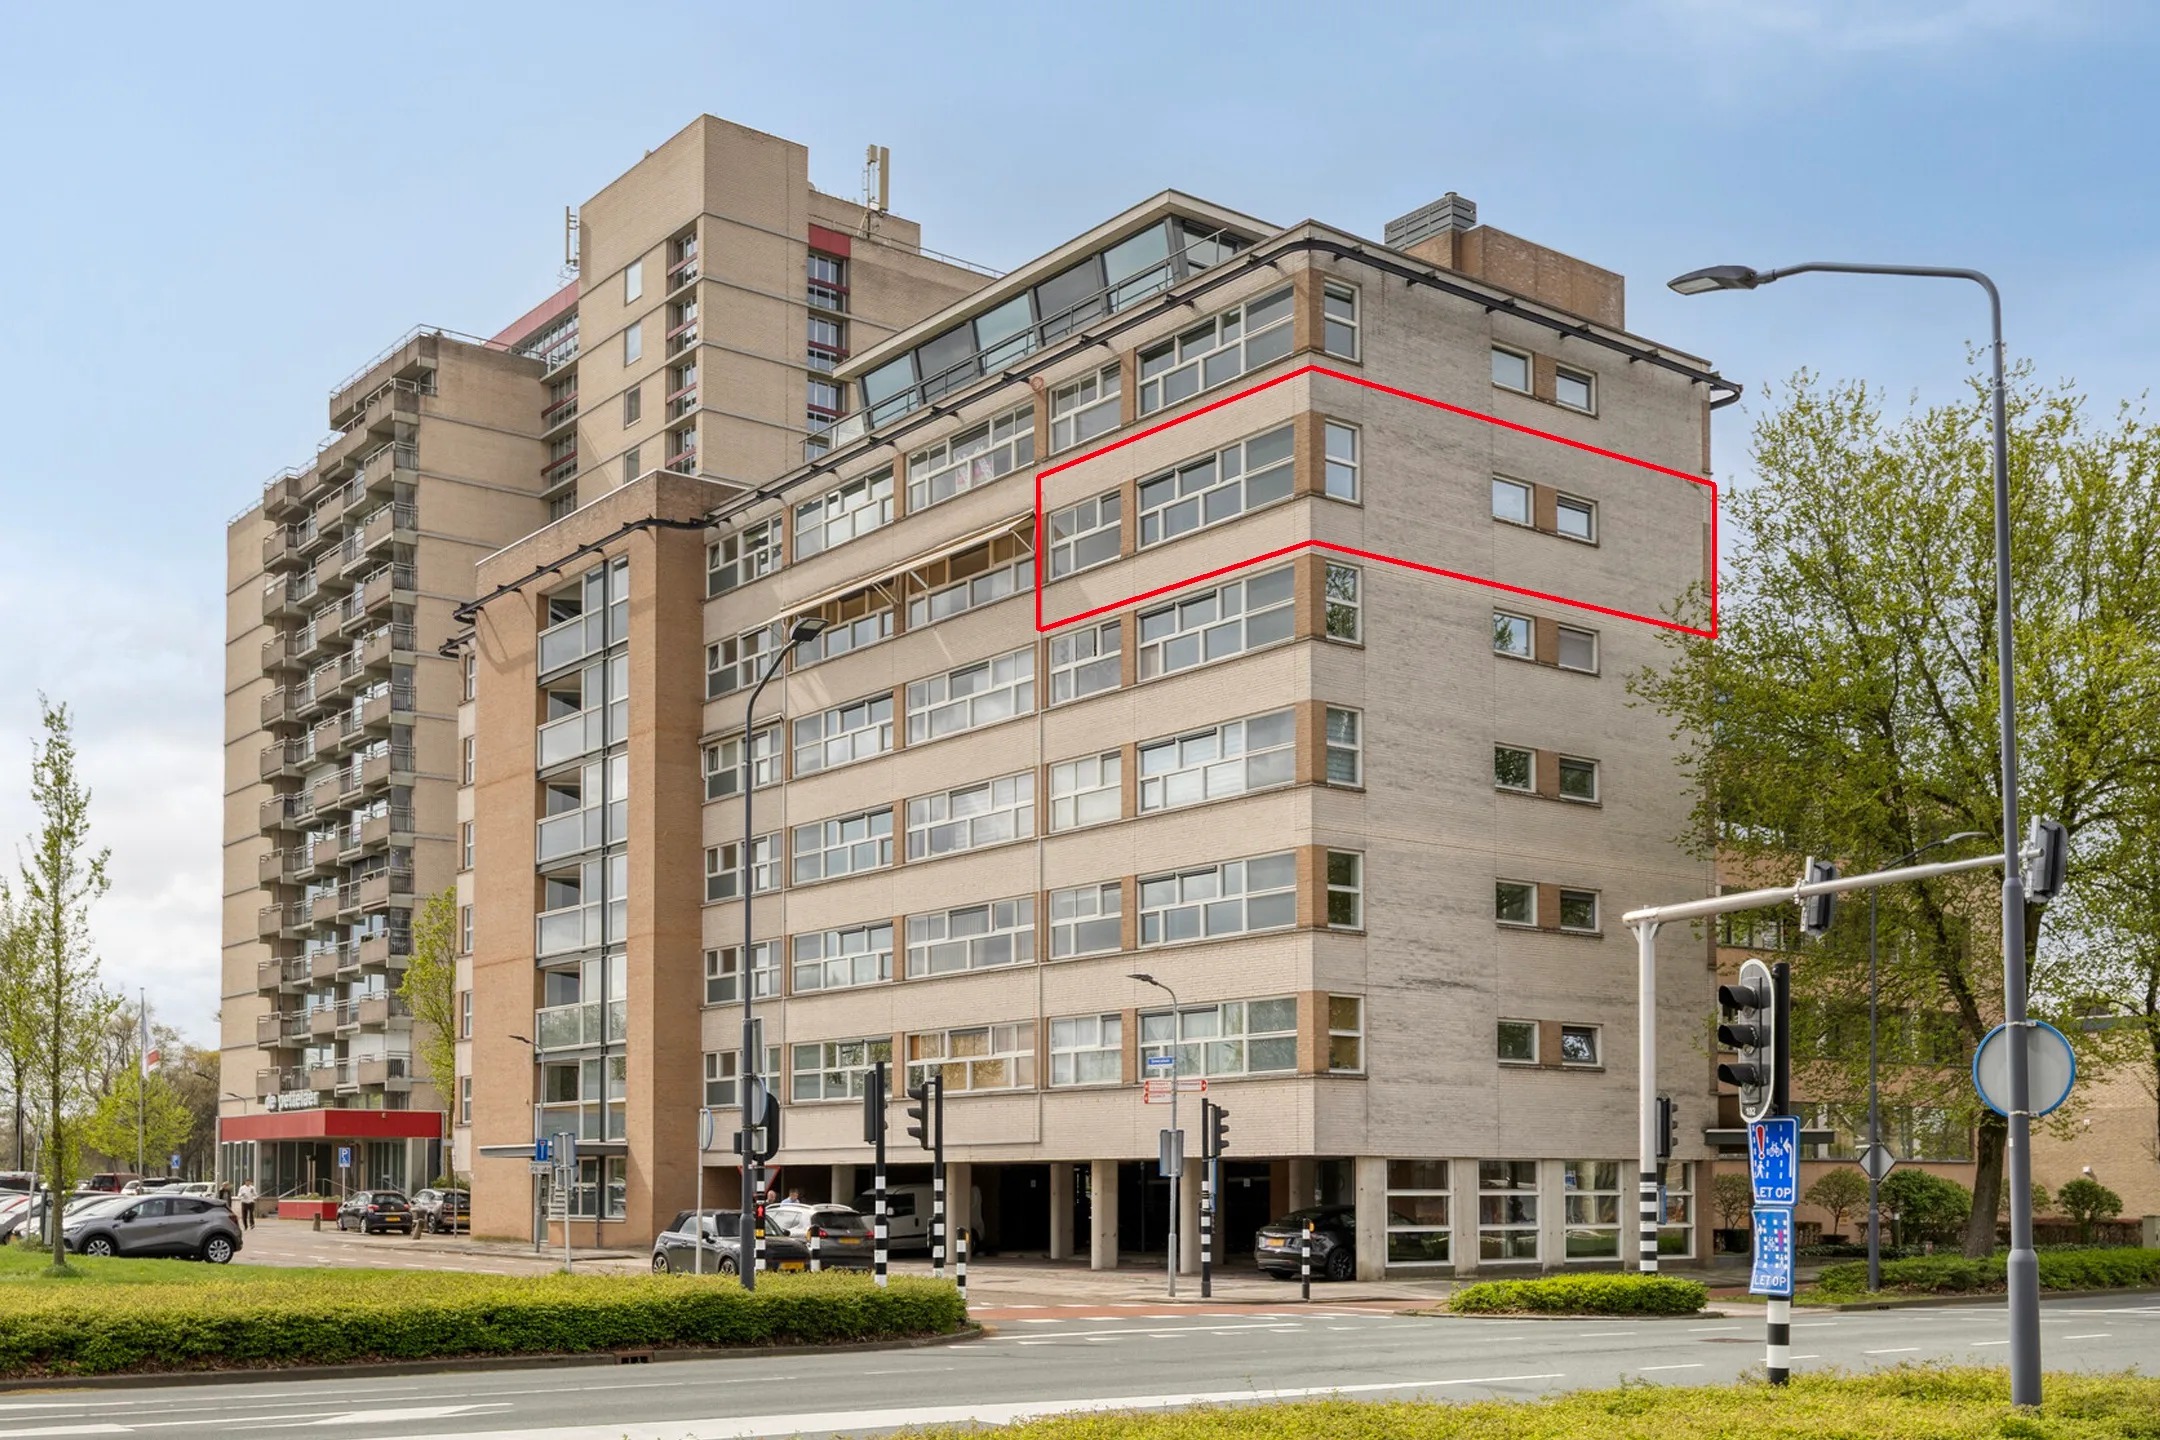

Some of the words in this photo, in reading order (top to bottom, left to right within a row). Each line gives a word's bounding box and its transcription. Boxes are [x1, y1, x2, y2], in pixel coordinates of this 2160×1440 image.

[1755, 1187, 1774, 1198] LET
[1775, 1187, 1792, 1198] OP
[1754, 1275, 1770, 1286] LET
[1772, 1276, 1787, 1287] OP
